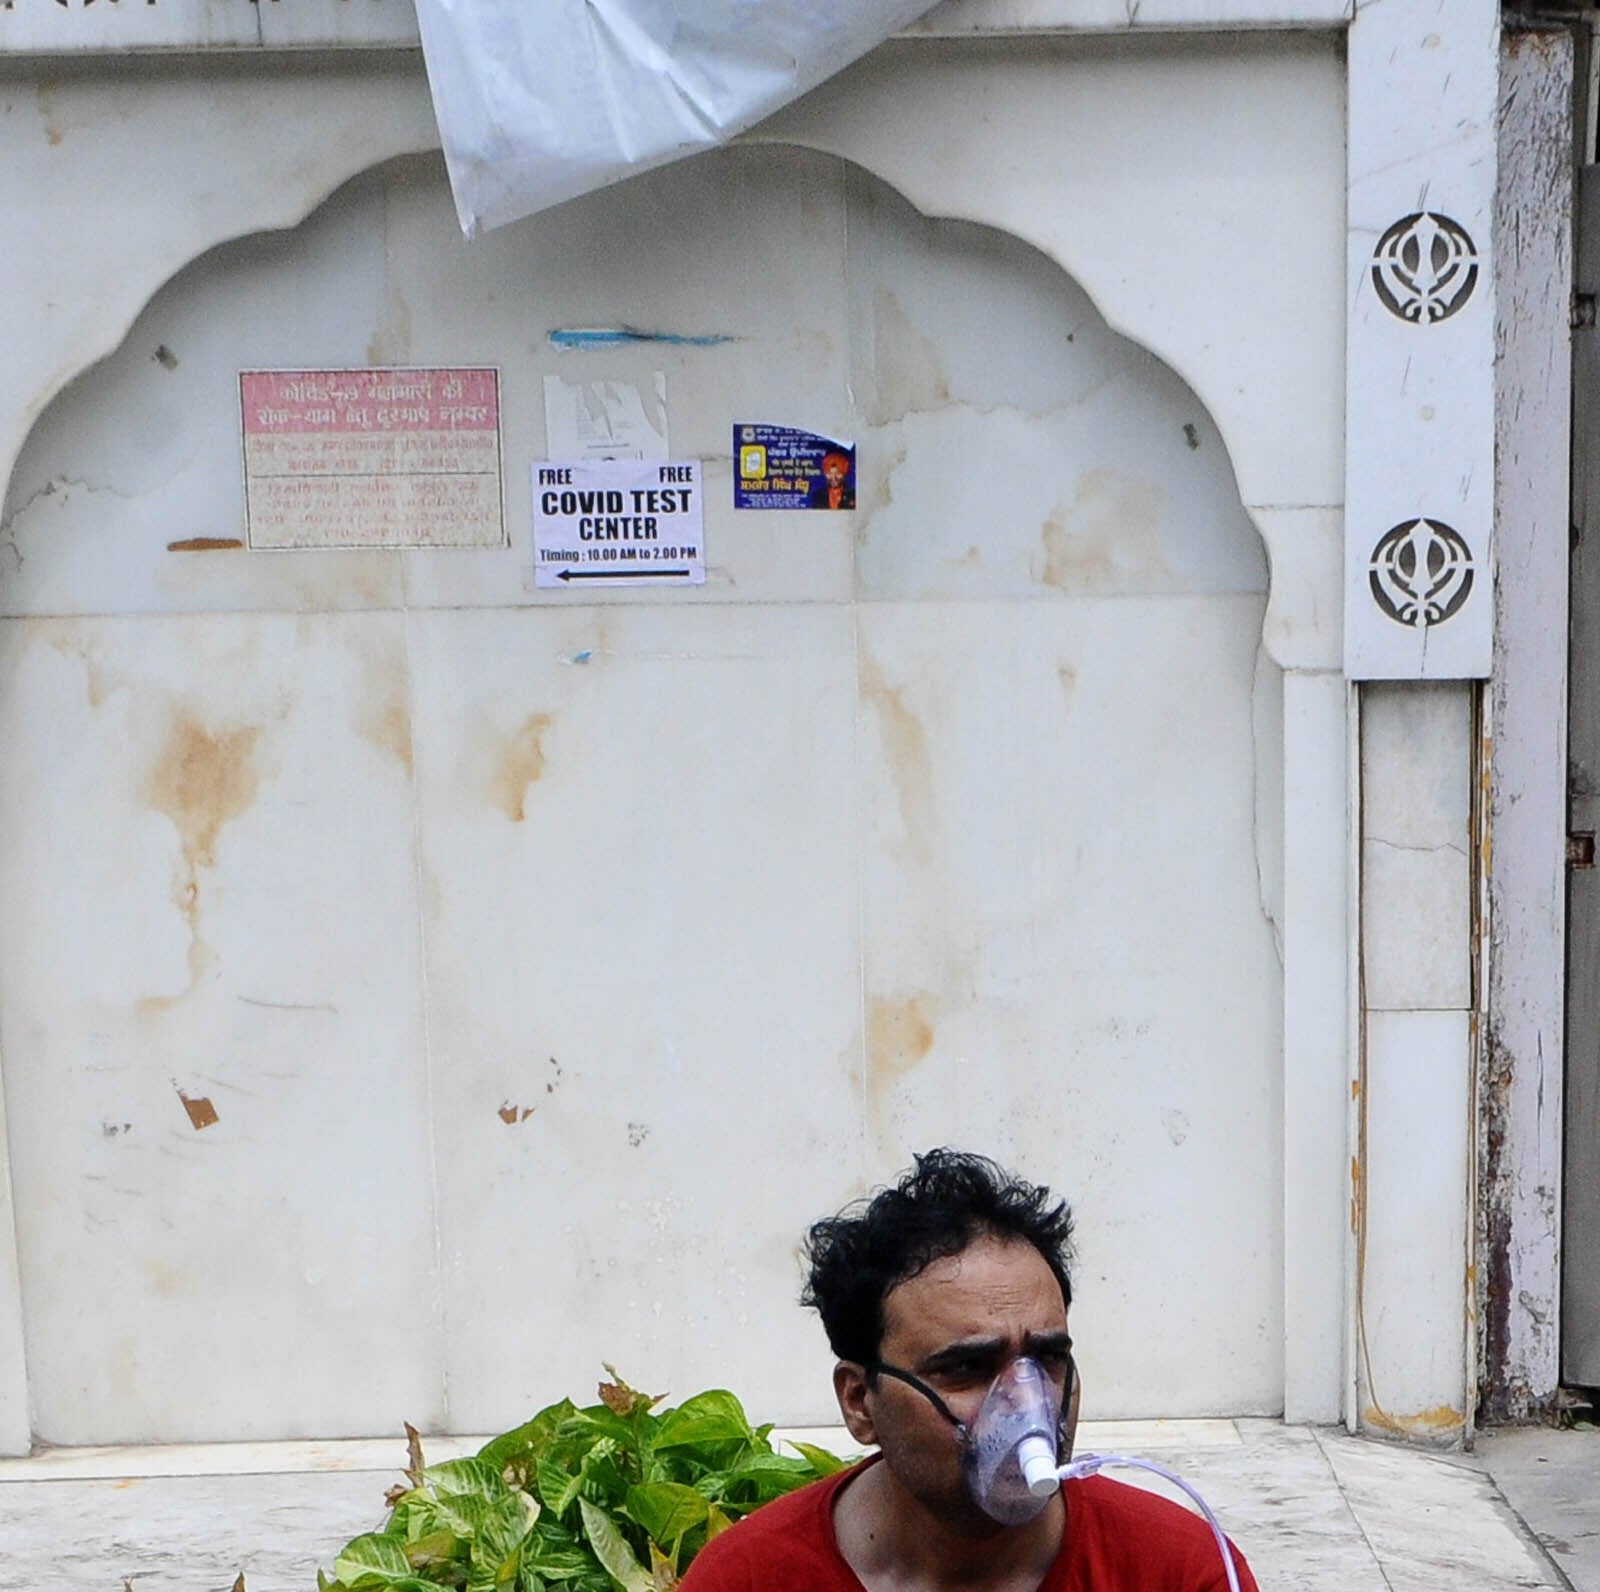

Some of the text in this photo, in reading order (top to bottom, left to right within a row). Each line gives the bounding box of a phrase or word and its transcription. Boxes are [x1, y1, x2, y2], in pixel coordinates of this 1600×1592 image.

[539, 466, 693, 486] FREE FREE
[541, 488, 693, 516] COVID TEST
[579, 516, 659, 542] CENTER
[540, 547, 580, 562] Timing
[588, 547, 618, 561] 10.00
[620, 547, 636, 560] AM
[639, 546, 651, 560] to
[653, 546, 678, 560] 2.00
[680, 546, 698, 560] PM
